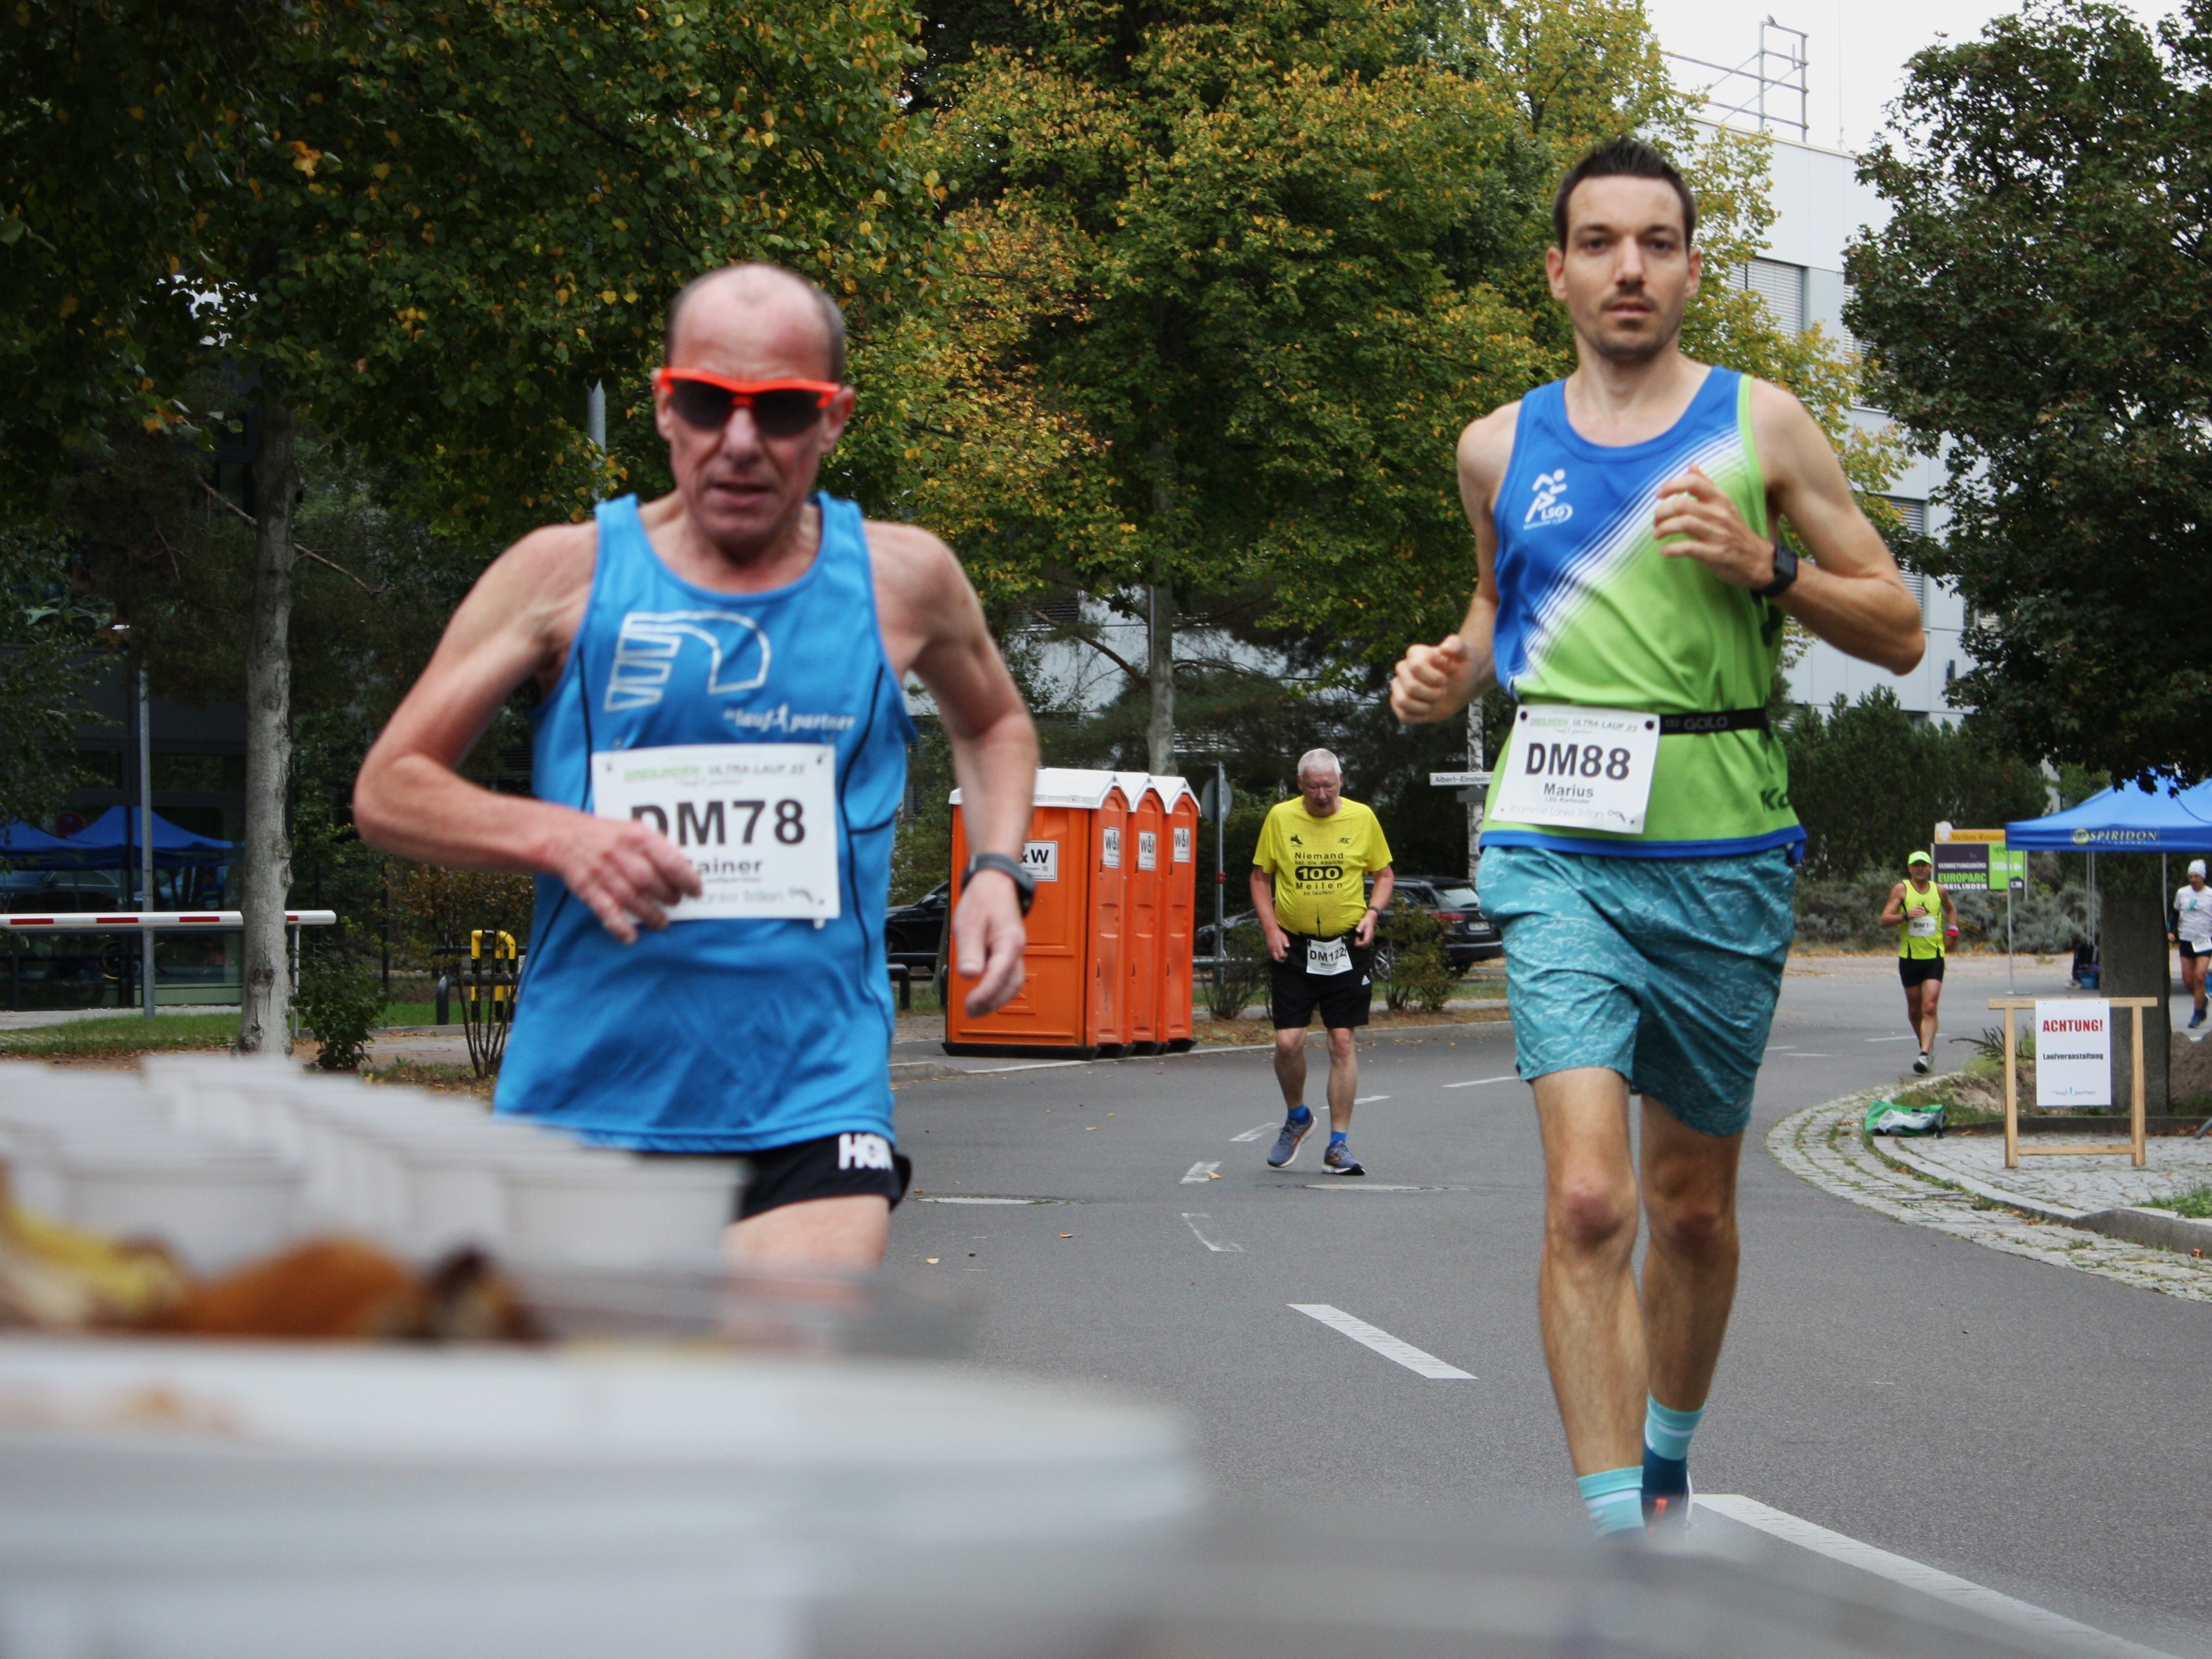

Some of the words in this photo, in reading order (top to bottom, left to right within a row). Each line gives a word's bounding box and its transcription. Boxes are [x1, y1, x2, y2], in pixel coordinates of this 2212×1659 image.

[1524, 742, 1631, 781] DM88
[1543, 783, 1594, 798] Marius
[2089, 830, 2157, 841] SPIRIDON
[689, 858, 763, 875] ainer
[1298, 868, 1340, 879] 100
[1938, 873, 1987, 883] EUROPARC
[2042, 1019, 2103, 1032] ACHTUNG!
[2042, 1052, 2103, 1061] Laufveranstaltung
